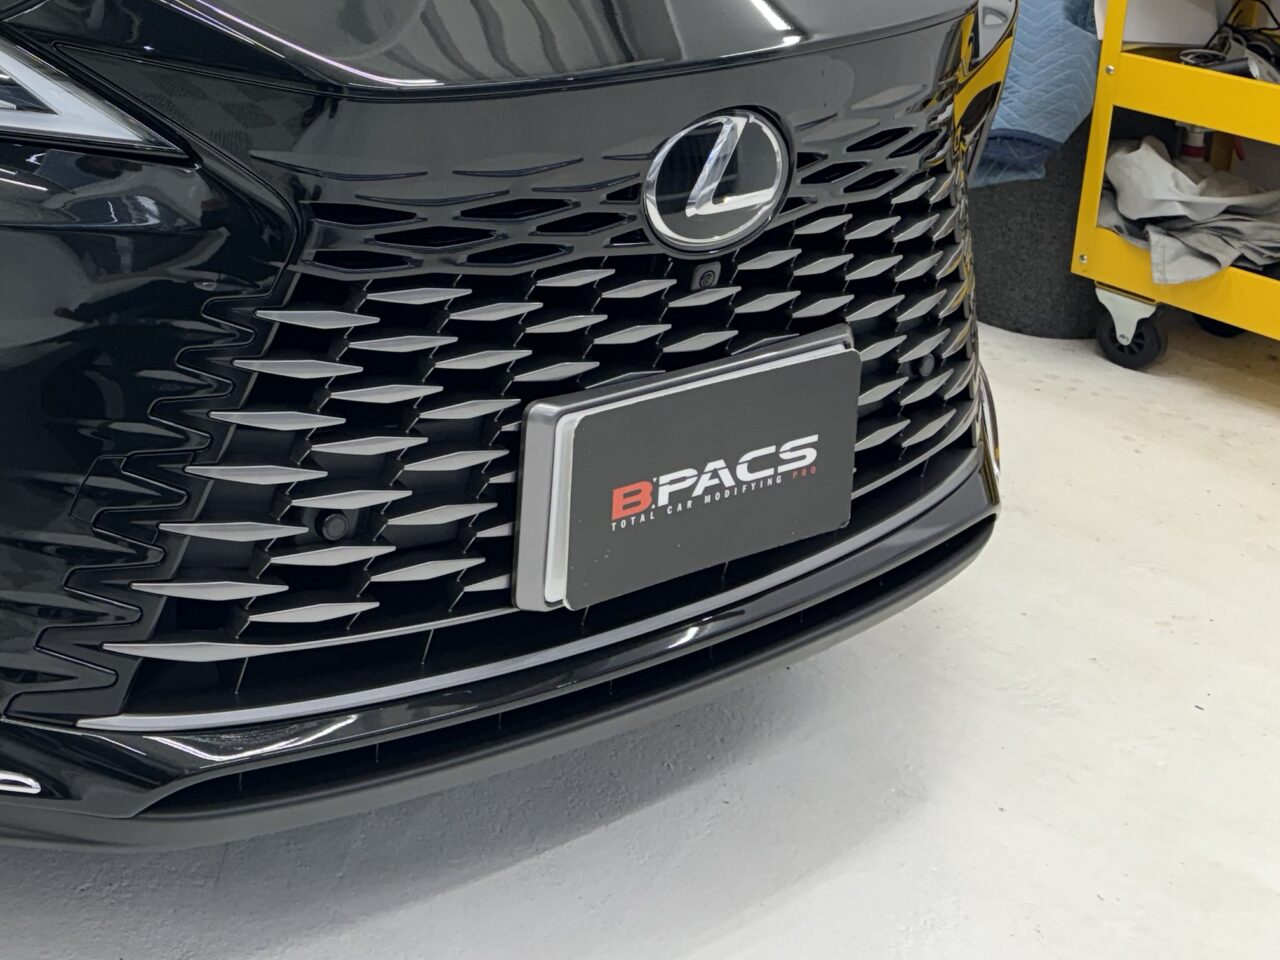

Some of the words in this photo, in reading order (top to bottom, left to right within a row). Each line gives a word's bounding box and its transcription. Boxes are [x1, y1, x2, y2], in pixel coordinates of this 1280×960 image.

[611, 511, 655, 532] TOTAL
[667, 500, 693, 515] CAR
[704, 475, 782, 504] MODIFYING
[792, 466, 817, 480] PRO
